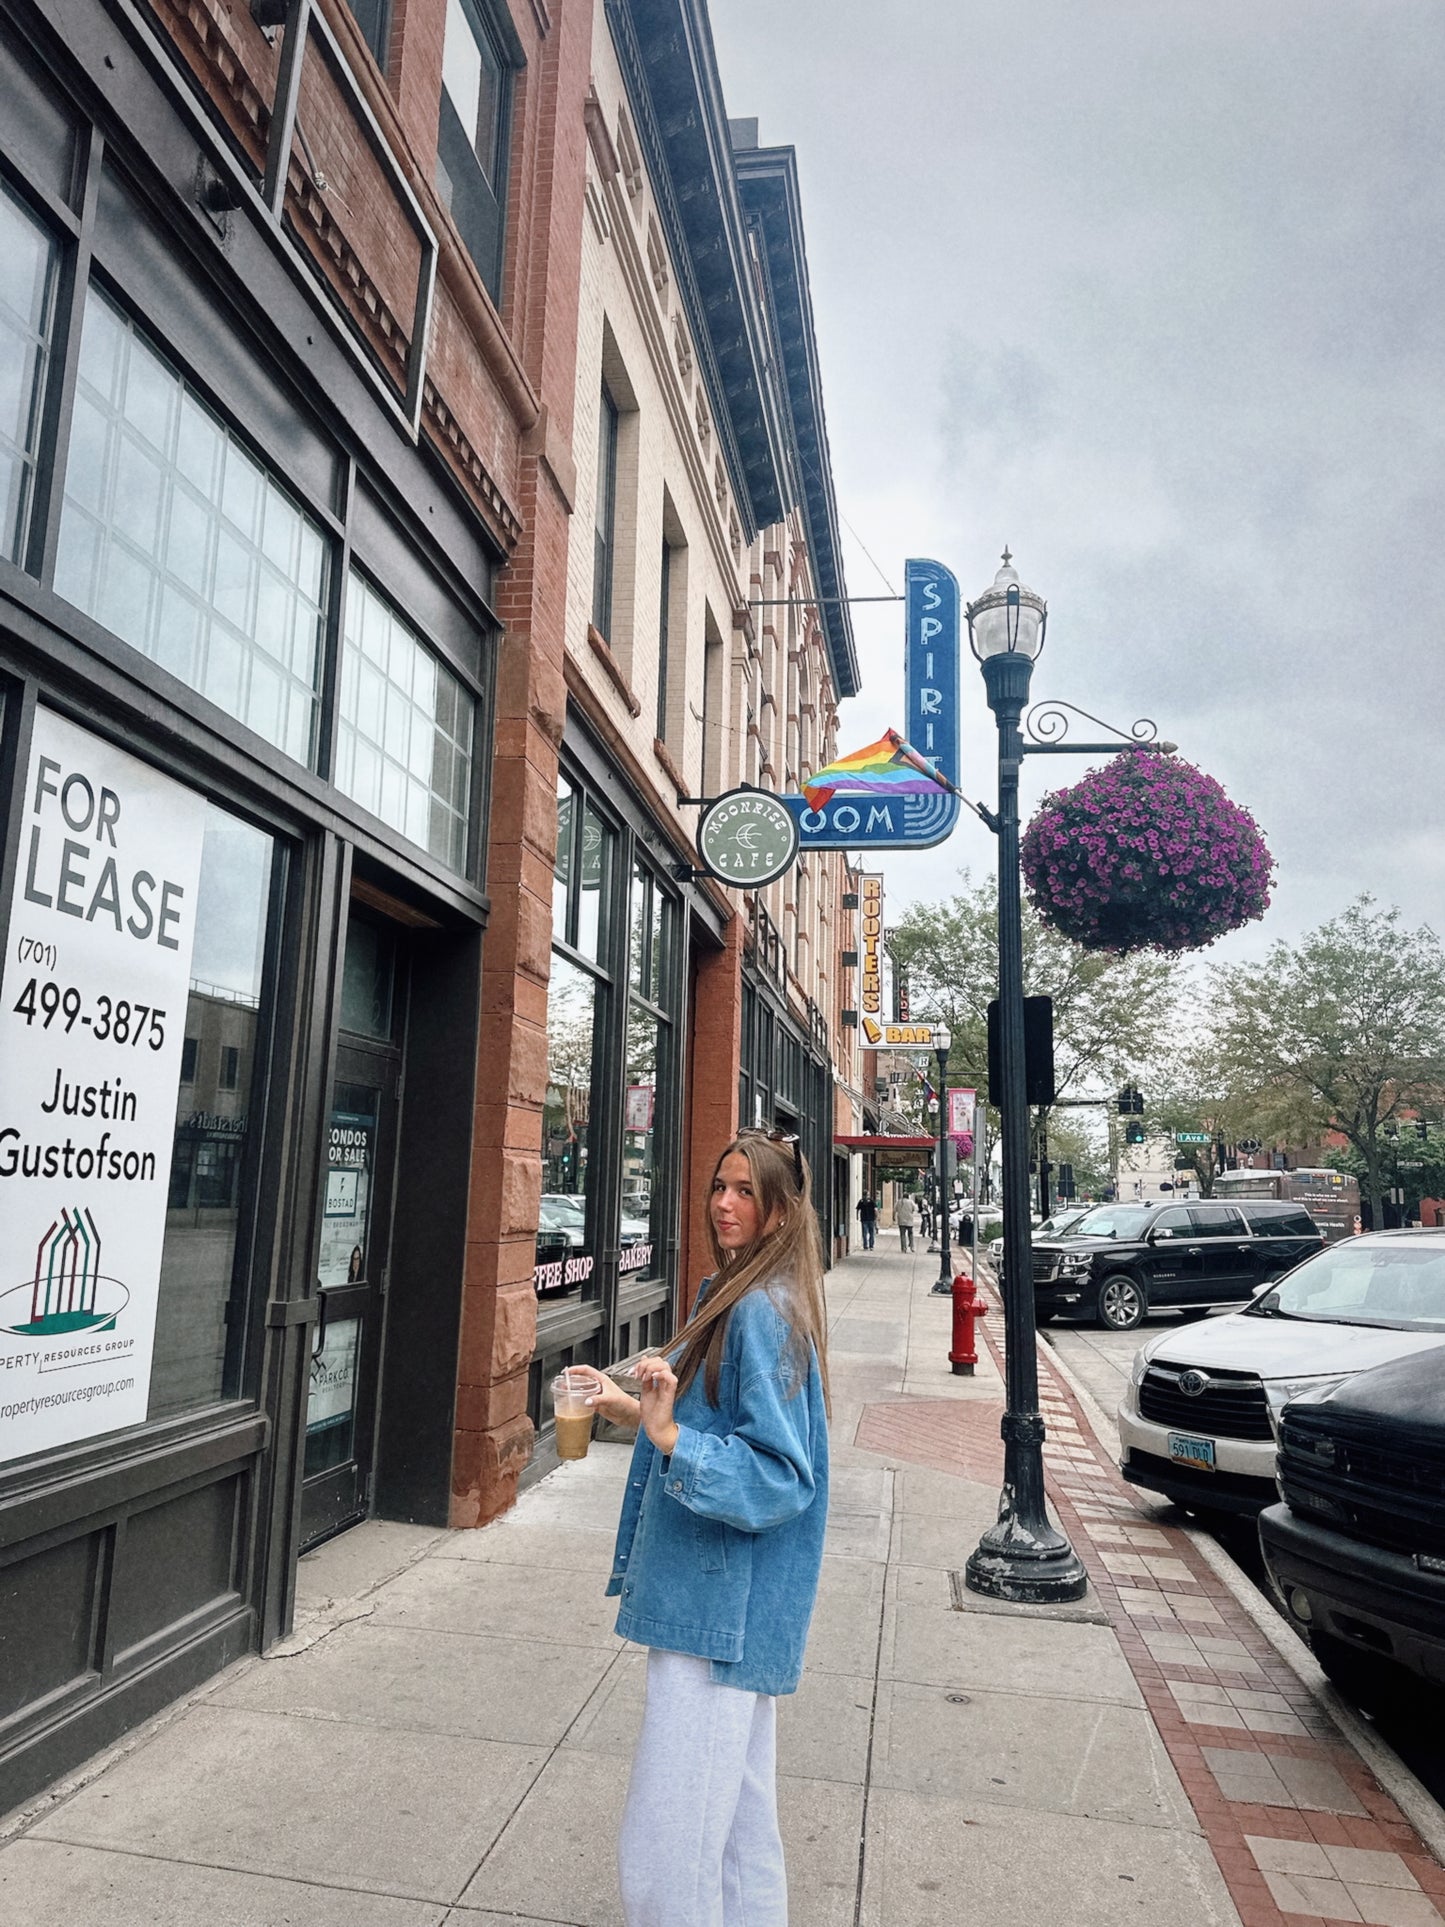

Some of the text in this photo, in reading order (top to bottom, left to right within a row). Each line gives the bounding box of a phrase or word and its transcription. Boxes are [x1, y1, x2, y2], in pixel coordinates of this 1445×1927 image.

[34, 754, 121, 848] FOR
[708, 801, 788, 835] MOONRISE
[719, 852, 774, 868] CAFE
[24, 824, 184, 951] LEASE
[18, 936, 57, 972] (701)
[863, 879, 881, 1014] ROOTERS
[13, 977, 167, 1051] 499-3875
[886, 1026, 932, 1044] BAR
[41, 1068, 138, 1122] Justin
[1185, 1133, 1203, 1141] Ave
[0, 1127, 156, 1181] Gustofson
[344, 1147, 366, 1163] SALE
[328, 1198, 353, 1208] BOSTAD
[564, 1256, 594, 1285] SHOP
[619, 1241, 653, 1272] BAKERY
[43, 1344, 102, 1363] RESOURCES
[105, 1339, 135, 1352] GROUP
[0, 1377, 135, 1420] ropertyresourcesgroup.com
[1173, 1442, 1189, 1458] 591
